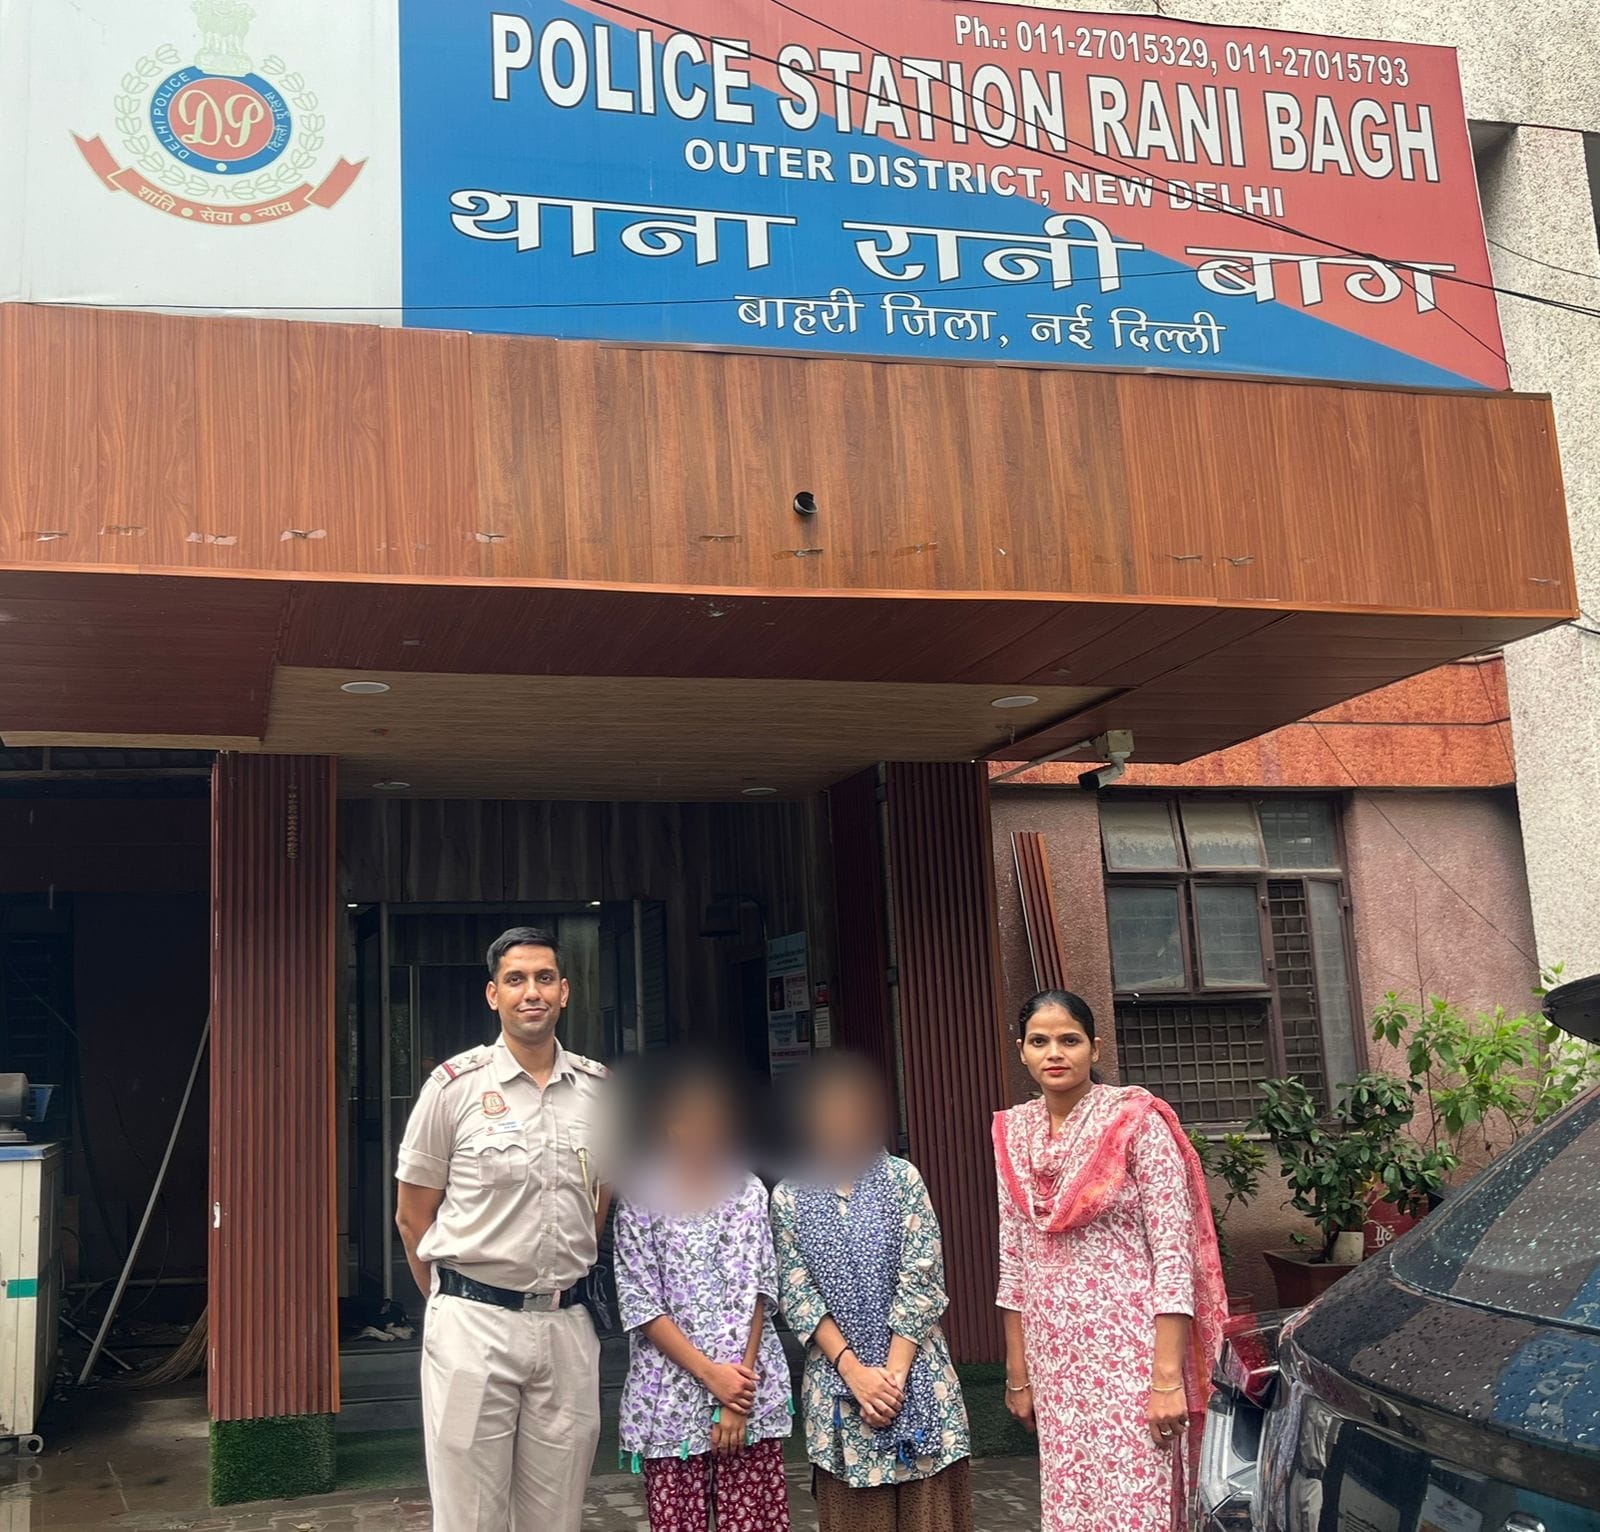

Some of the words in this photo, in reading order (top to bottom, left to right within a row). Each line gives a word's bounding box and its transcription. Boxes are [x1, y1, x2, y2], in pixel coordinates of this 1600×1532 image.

[955, 14, 1009, 51] Ph.:
[1015, 21, 1218, 76] 011-27015329,
[1225, 40, 1410, 88] 011-27015793
[153, 71, 191, 117] POLICE
[490, 11, 755, 125] POLICE
[776, 44, 1066, 154] STATION
[1086, 74, 1246, 168] RANI
[1264, 91, 1440, 184] BAGH
[153, 120, 190, 160] DELHI
[200, 206, 234, 224] सेवा
[254, 201, 294, 219] न्याय
[684, 137, 836, 183] OUTER
[849, 151, 1051, 206] DISTRICT,
[1064, 170, 1153, 209] NEW
[1167, 178, 1285, 218] DELHI
[449, 188, 797, 271] थाना
[842, 213, 1144, 293] रानी
[1185, 246, 1456, 314] बाग
[734, 287, 865, 337] बाहरी
[1027, 303, 1094, 351] नई
[1109, 307, 1227, 355] दिल्ली
